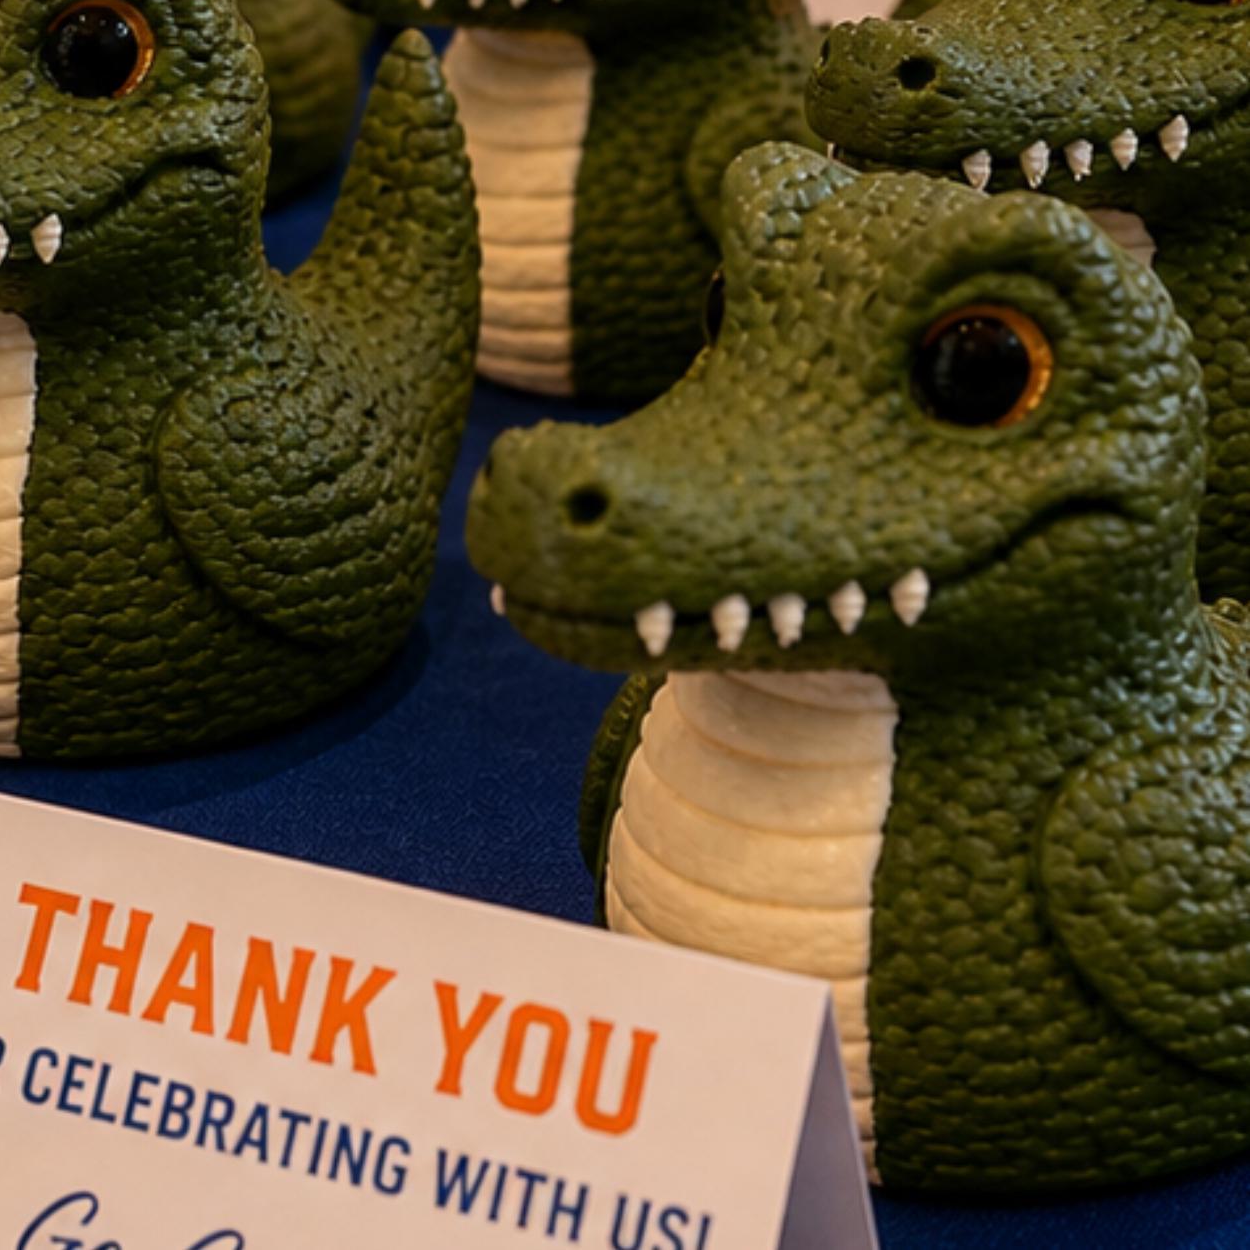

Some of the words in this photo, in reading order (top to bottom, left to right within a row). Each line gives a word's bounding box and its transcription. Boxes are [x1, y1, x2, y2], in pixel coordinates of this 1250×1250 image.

[14, 882, 397, 1077] THANK
[433, 980, 658, 1137] YOU
[21, 1047, 412, 1196] CELEBRATING
[435, 1148, 589, 1242] WITH
